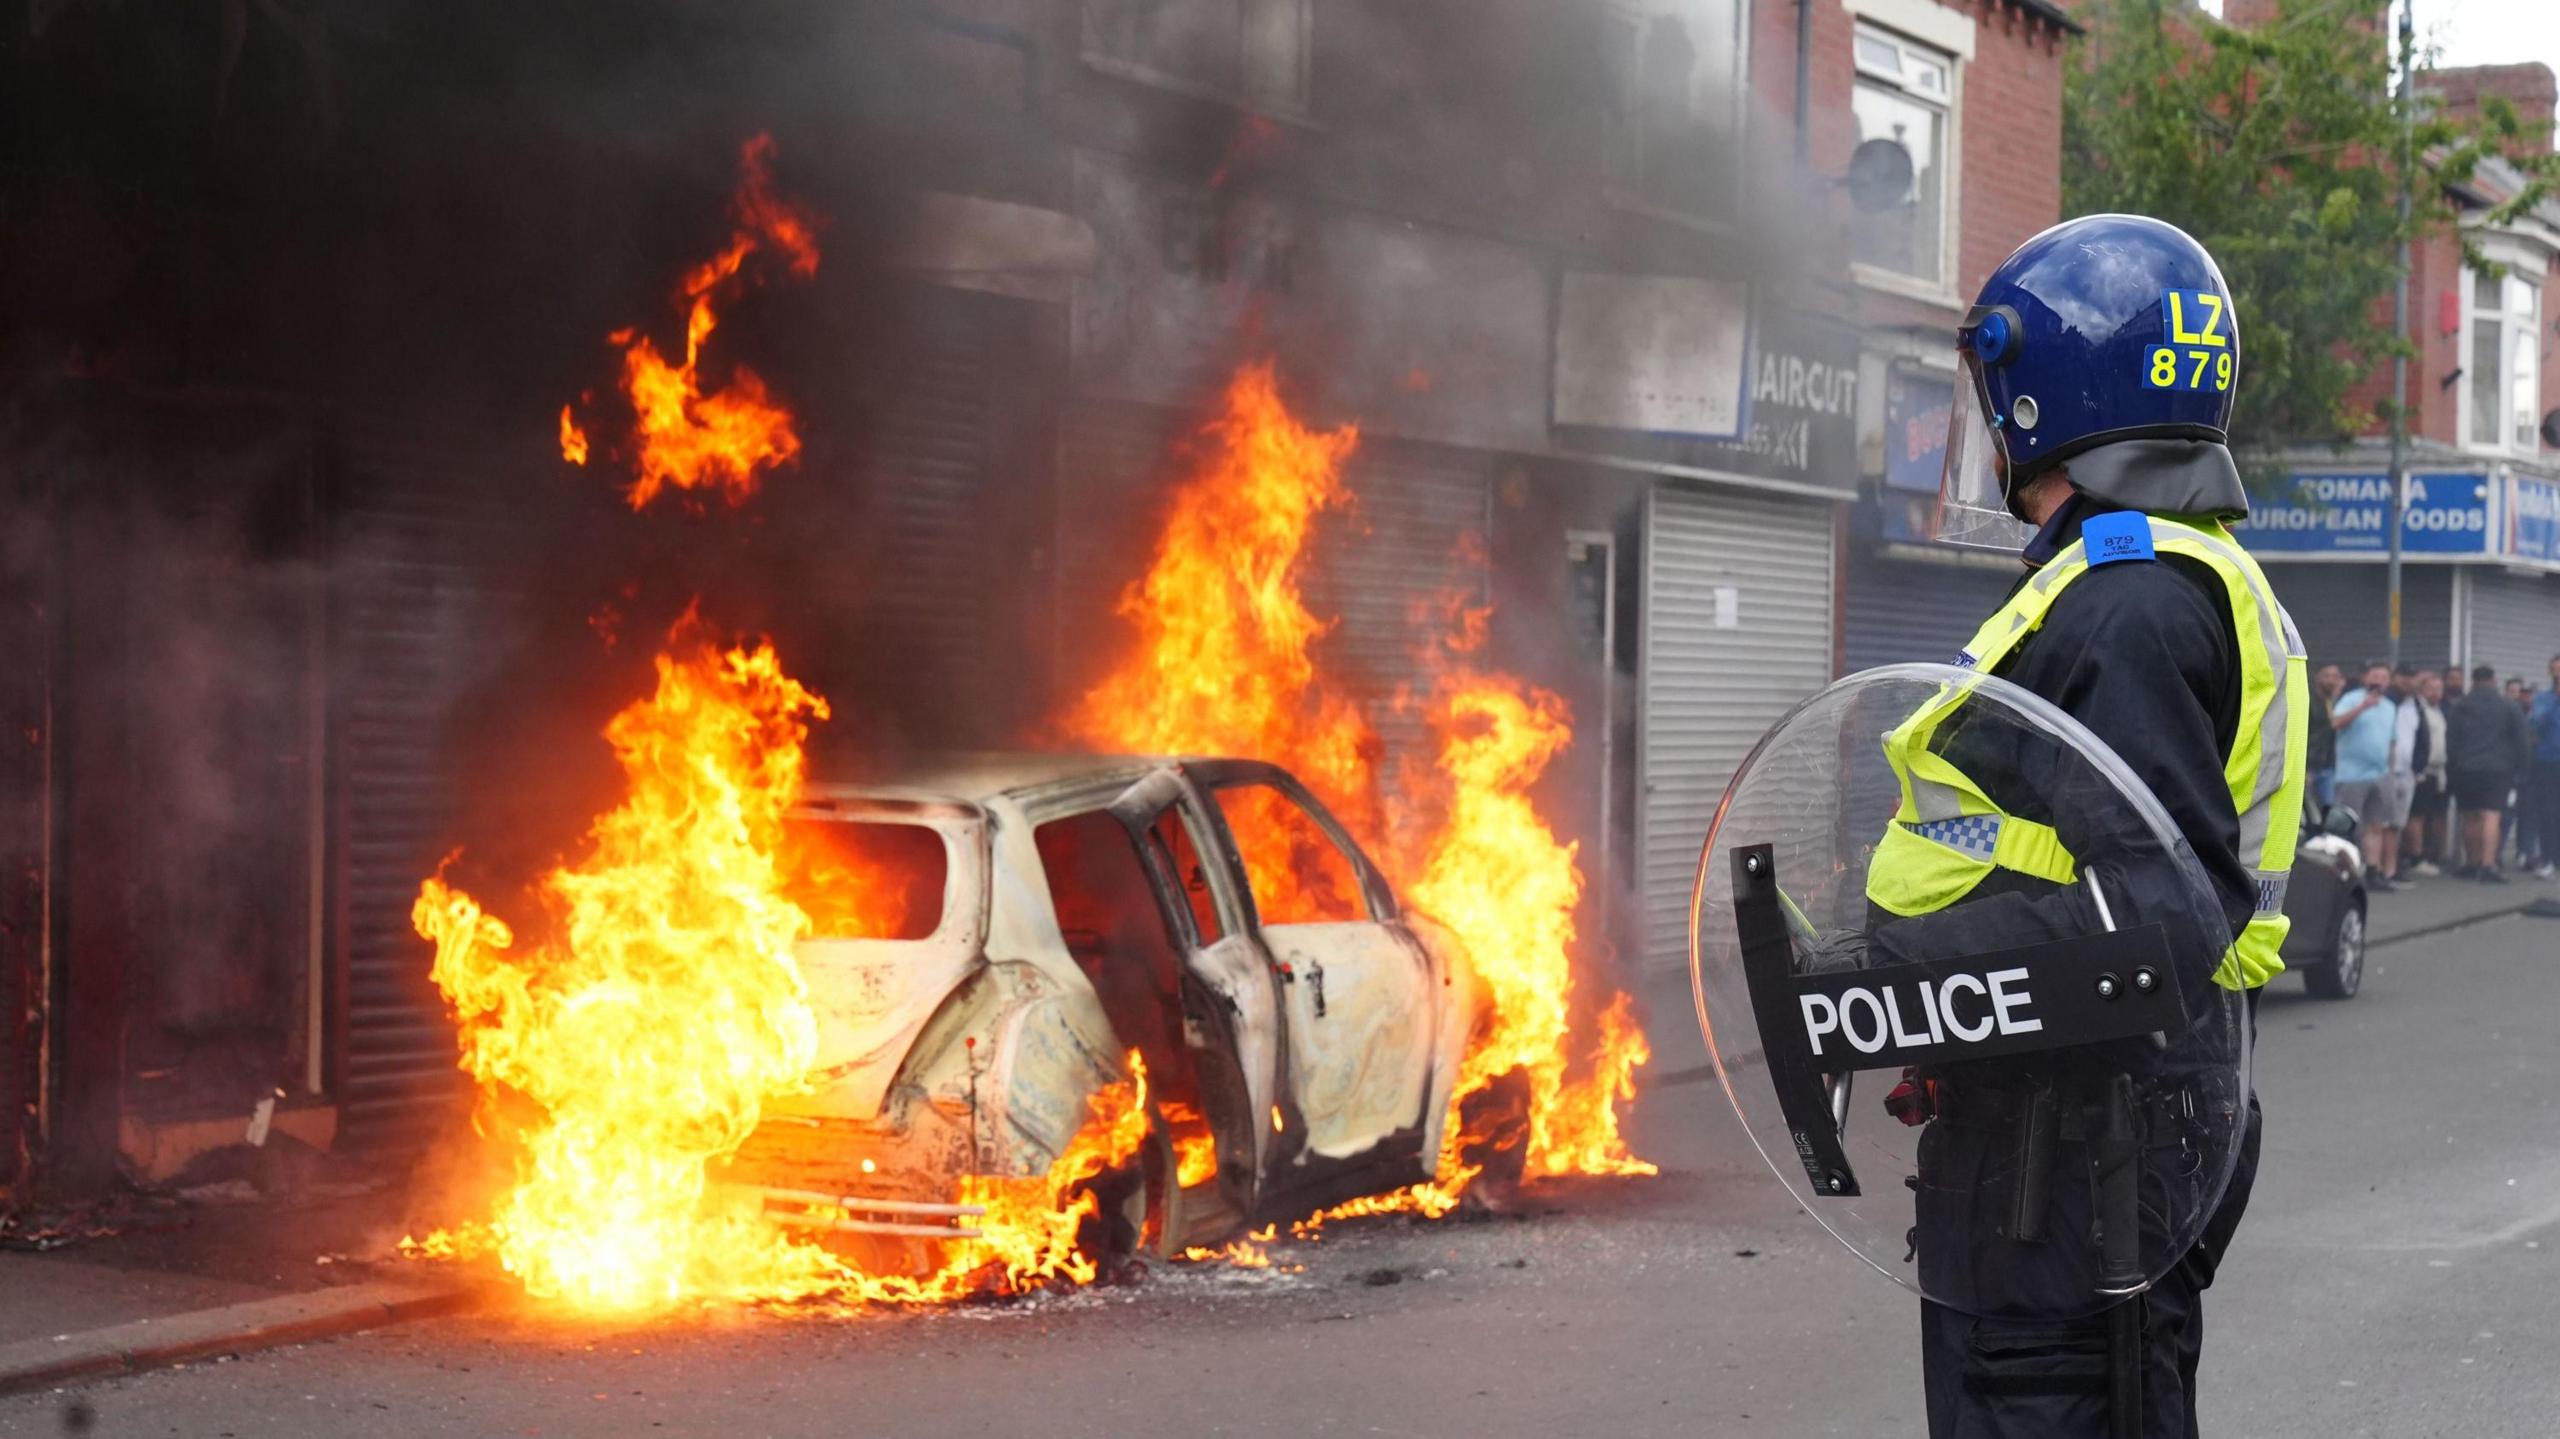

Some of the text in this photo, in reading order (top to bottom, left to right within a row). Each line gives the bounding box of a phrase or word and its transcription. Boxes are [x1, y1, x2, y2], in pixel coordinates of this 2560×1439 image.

[2169, 292, 2226, 347] LZ
[2150, 348, 2232, 391] 879
[2298, 478, 2428, 502] OMANA
[2402, 508, 2484, 532] OODS
[2104, 535, 2135, 547] 879
[1799, 967, 2043, 1056] POLICE
